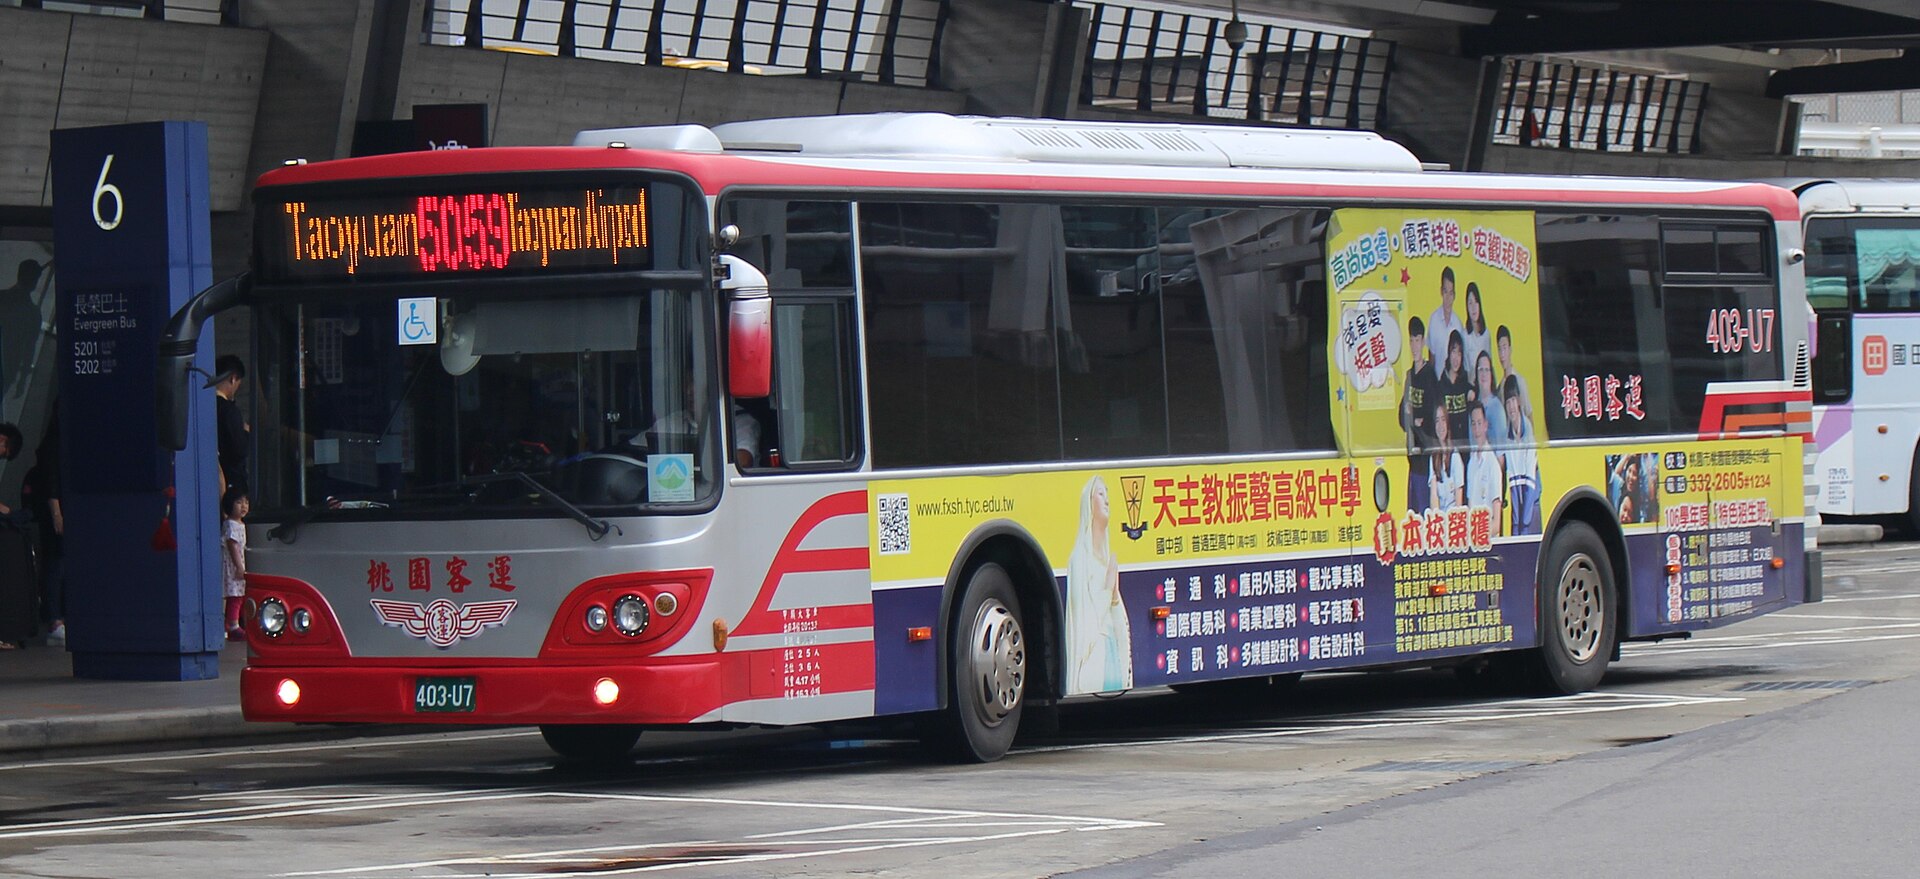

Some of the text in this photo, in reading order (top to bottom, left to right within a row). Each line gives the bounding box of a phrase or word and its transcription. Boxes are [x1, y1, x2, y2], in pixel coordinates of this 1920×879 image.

[92, 153, 123, 231] 6
[416, 193, 510, 272] 5059
[74, 292, 128, 314] 長榮巴士
[73, 316, 137, 333] Evergreen Bus
[1706, 308, 1775, 353] 403-U7
[74, 341, 98, 357] 5201
[75, 359, 100, 375] 5202
[1560, 374, 1646, 421] 桃園客運
[916, 495, 1015, 518] www.fxsh.tyc.edu.tw
[1153, 466, 1362, 528] 天主教振聲高級中學
[1156, 535, 1184, 555] 國中部
[1402, 509, 1491, 551] 本校榮獲
[366, 555, 518, 594] 桃園客運
[1239, 568, 1297, 598] 應用外語科
[1308, 563, 1365, 592] 觀光事業科
[1165, 608, 1227, 639] 國際貿易科
[1238, 603, 1297, 633] 商業經營科
[1241, 637, 1300, 668] 多媒體設計科
[1308, 631, 1365, 661] 廣告設計科
[415, 683, 475, 708] 403-U7
